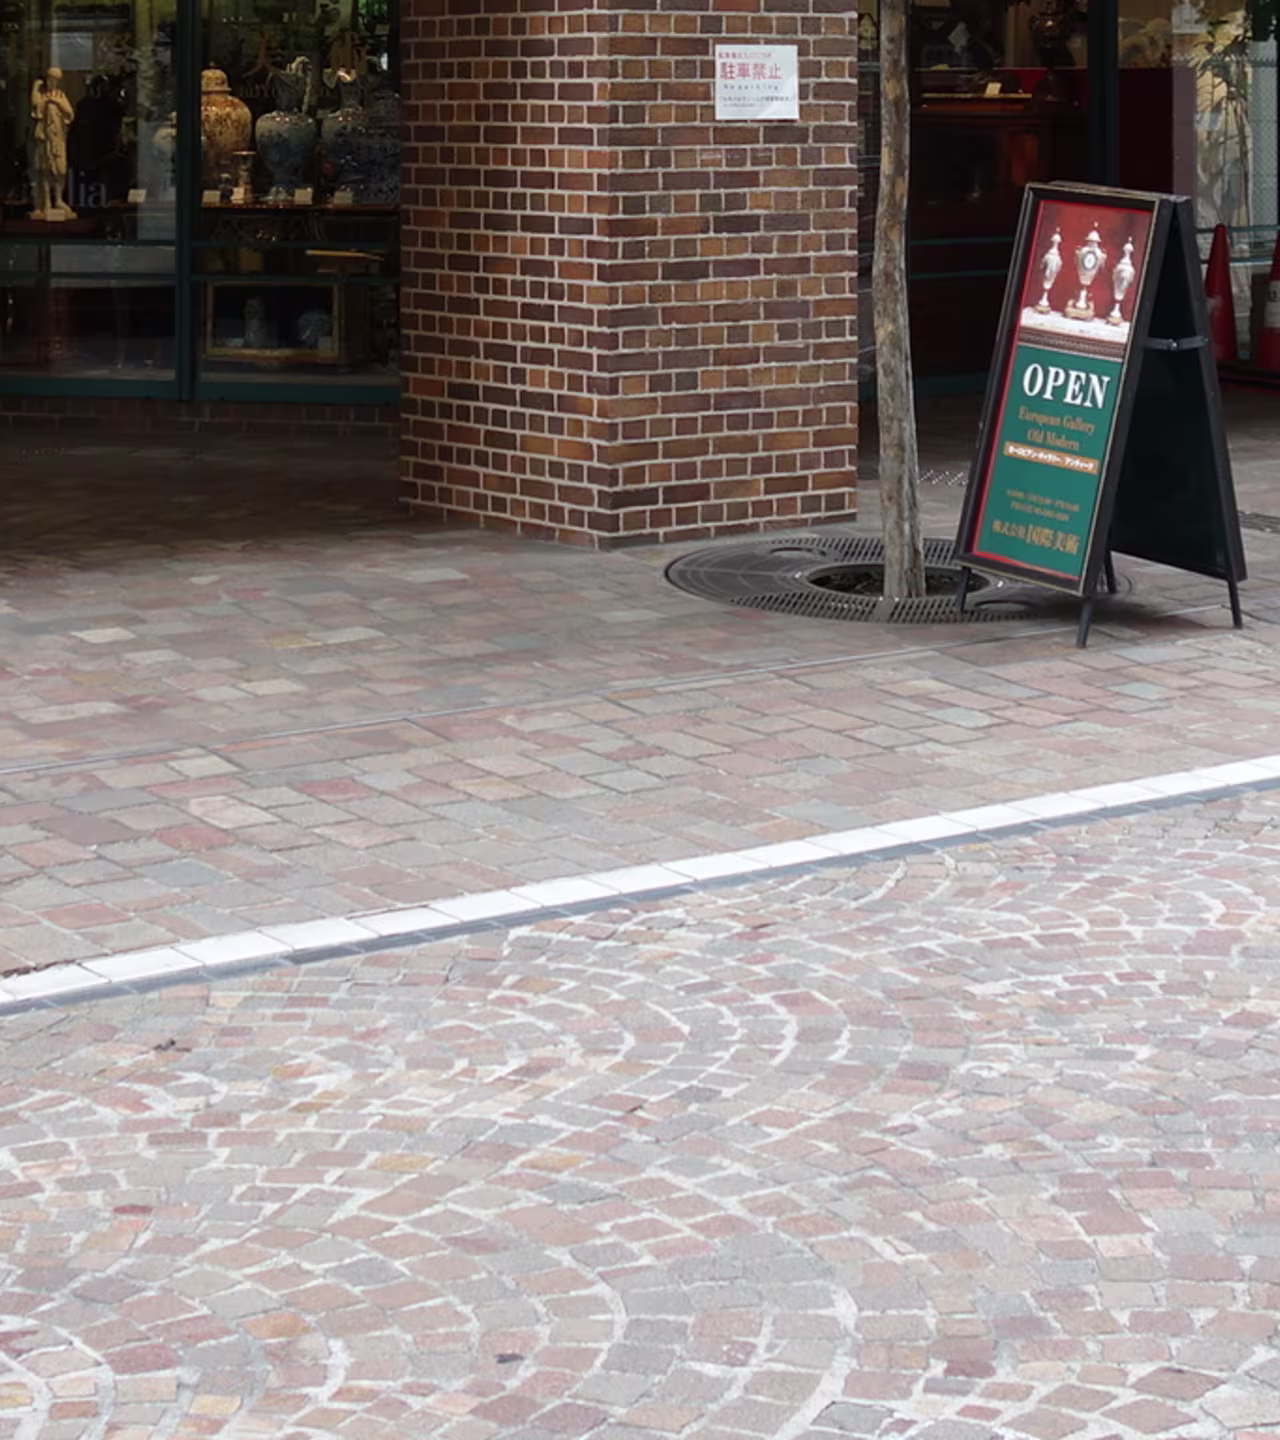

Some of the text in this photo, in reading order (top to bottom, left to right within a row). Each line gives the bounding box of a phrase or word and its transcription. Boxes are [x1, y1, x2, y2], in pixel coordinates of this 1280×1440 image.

[720, 62, 783, 80] 駐車禁止
[1022, 363, 1111, 409] OPEN
[1018, 405, 1061, 428] European
[1027, 428, 1045, 443] Old
